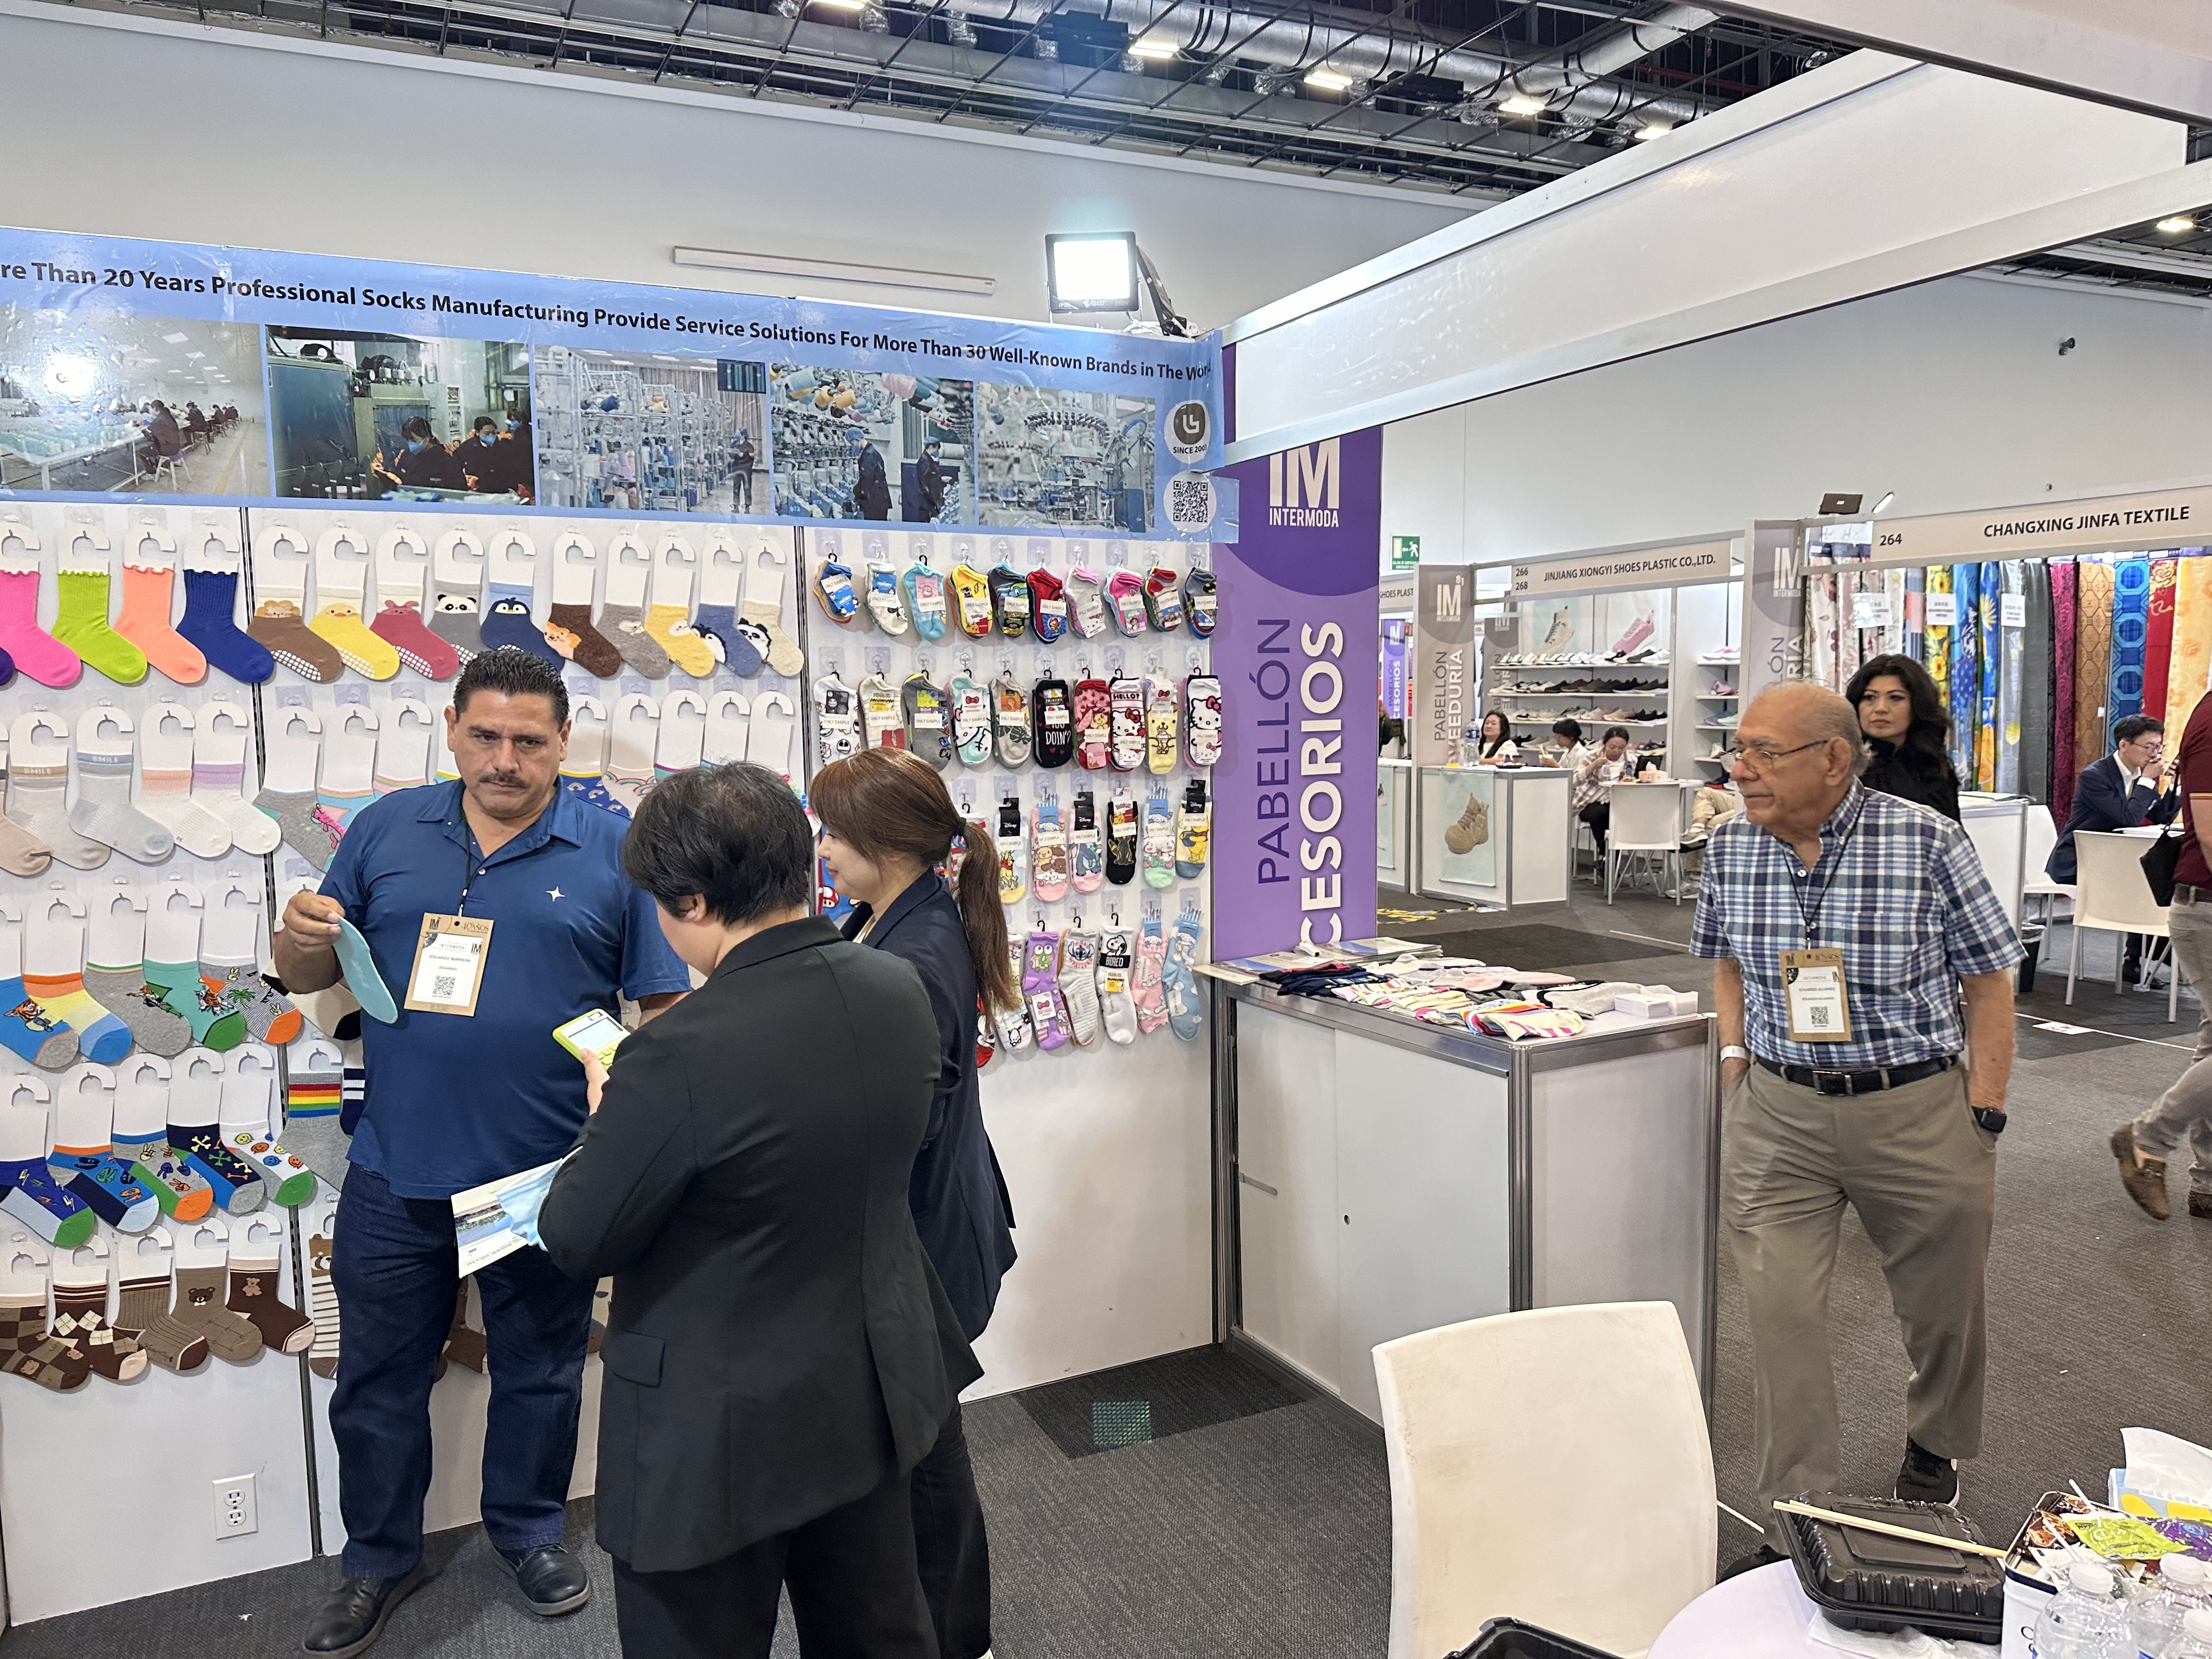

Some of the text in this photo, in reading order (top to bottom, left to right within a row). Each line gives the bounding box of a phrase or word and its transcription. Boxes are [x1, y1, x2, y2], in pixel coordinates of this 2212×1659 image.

[31, 262, 96, 285] Than
[103, 268, 134, 288] 20
[139, 271, 205, 294] Years
[212, 276, 356, 306] Professional
[362, 289, 426, 311] Socks
[432, 294, 589, 328] Manufacturing
[594, 308, 670, 331] Provide
[675, 316, 745, 337] Service
[749, 321, 836, 345] Solutions
[840, 330, 868, 349] For
[873, 334, 917, 353] More
[920, 339, 962, 357] Than
[966, 344, 985, 360] 30
[989, 346, 1082, 370] Well-Known
[1086, 357, 1137, 376] Brands
[1141, 361, 1154, 377] in
[1157, 363, 1183, 380] The
[1269, 437, 1340, 510] IM
[1269, 507, 1339, 528] INTERMODA
[1984, 506, 2191, 538] CHANGXING JINFA TEXTILE
[1879, 533, 1903, 546] 264
[1455, 575, 1464, 586] 81
[1516, 567, 1529, 577] 266
[1544, 569, 1578, 582] JINJIANG
[1579, 565, 1612, 578] XIONGYI
[1614, 561, 1641, 574] SHOES
[1643, 557, 1678, 571] PLASTIC
[1515, 582, 1528, 591] 268
[1436, 584, 1461, 616] IM
[1432, 651, 1447, 741] PABELLÓN
[1249, 618, 1290, 884] PABELLÓN
[1105, 957, 1124, 967] BORED
